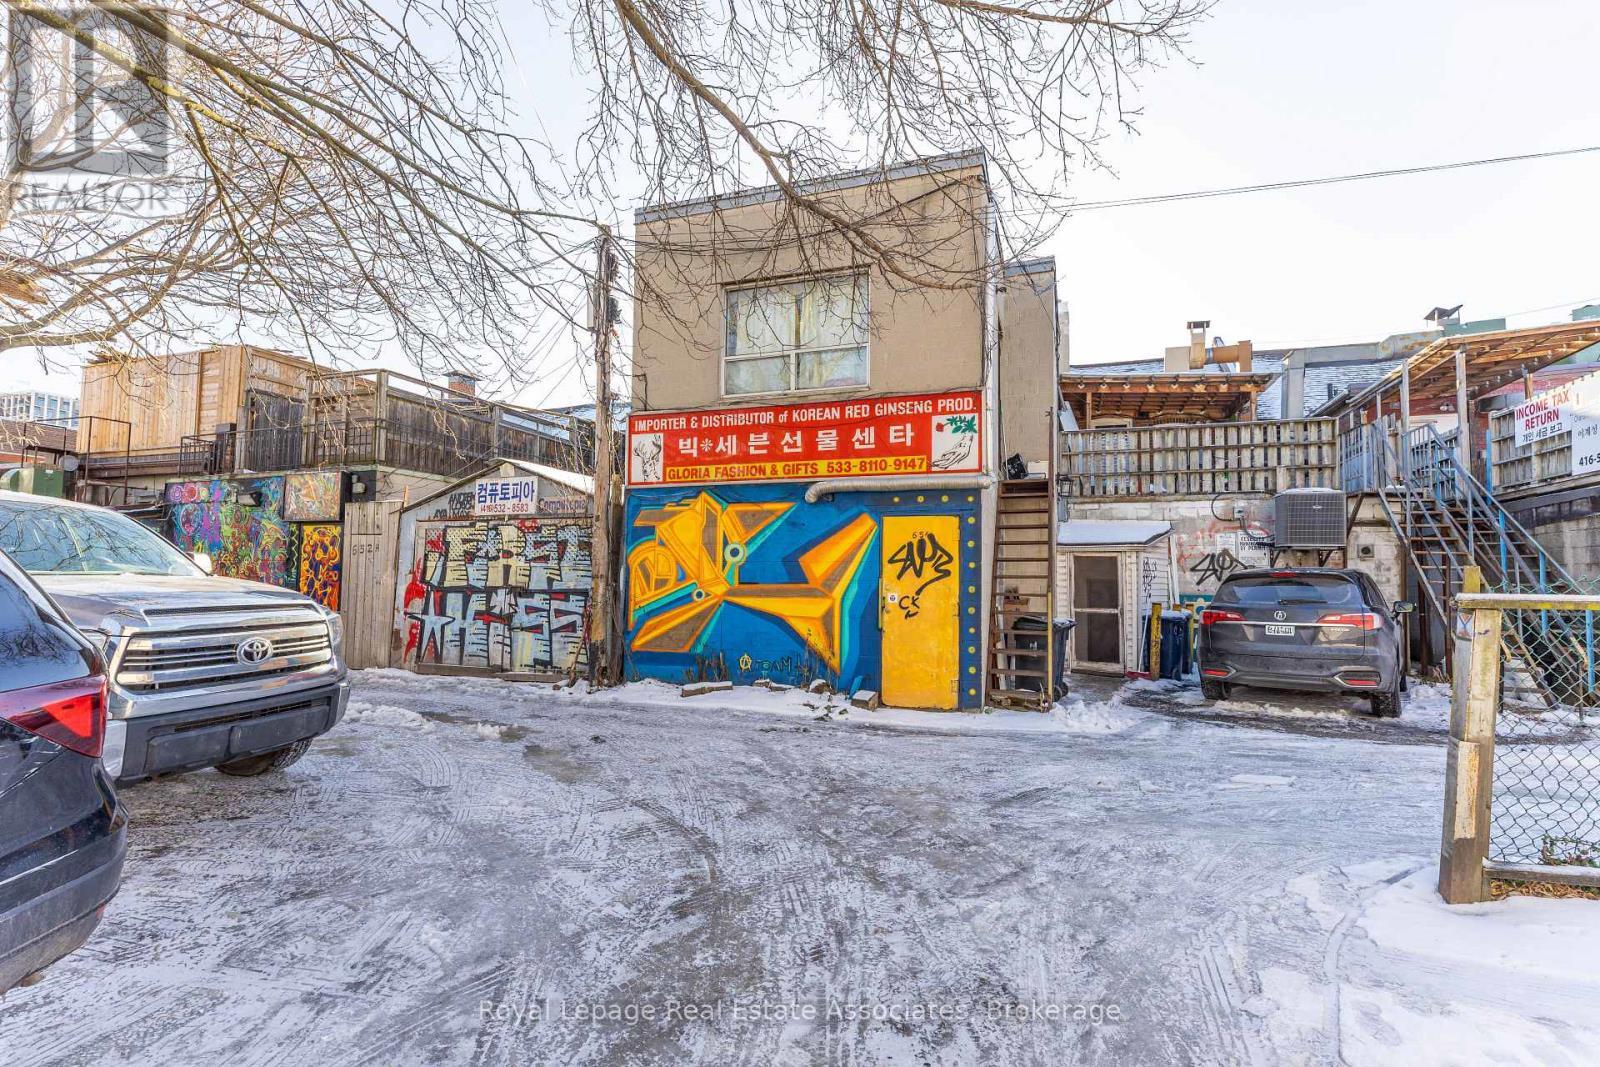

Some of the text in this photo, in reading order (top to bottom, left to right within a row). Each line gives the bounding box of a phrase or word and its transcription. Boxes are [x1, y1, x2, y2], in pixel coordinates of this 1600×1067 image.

[634, 397, 977, 432] IMPORTER & DISTRIBUTOR of KOREAN RED GINSENG PROD.
[1516, 398, 1549, 420] INCOME
[1552, 390, 1570, 407] TAX
[1525, 408, 1560, 431] RETURN
[668, 457, 925, 480] GLORIA FASHION & GIFTS 533-8110-9147
[477, 481, 535, 503] 컴퓨토피아
